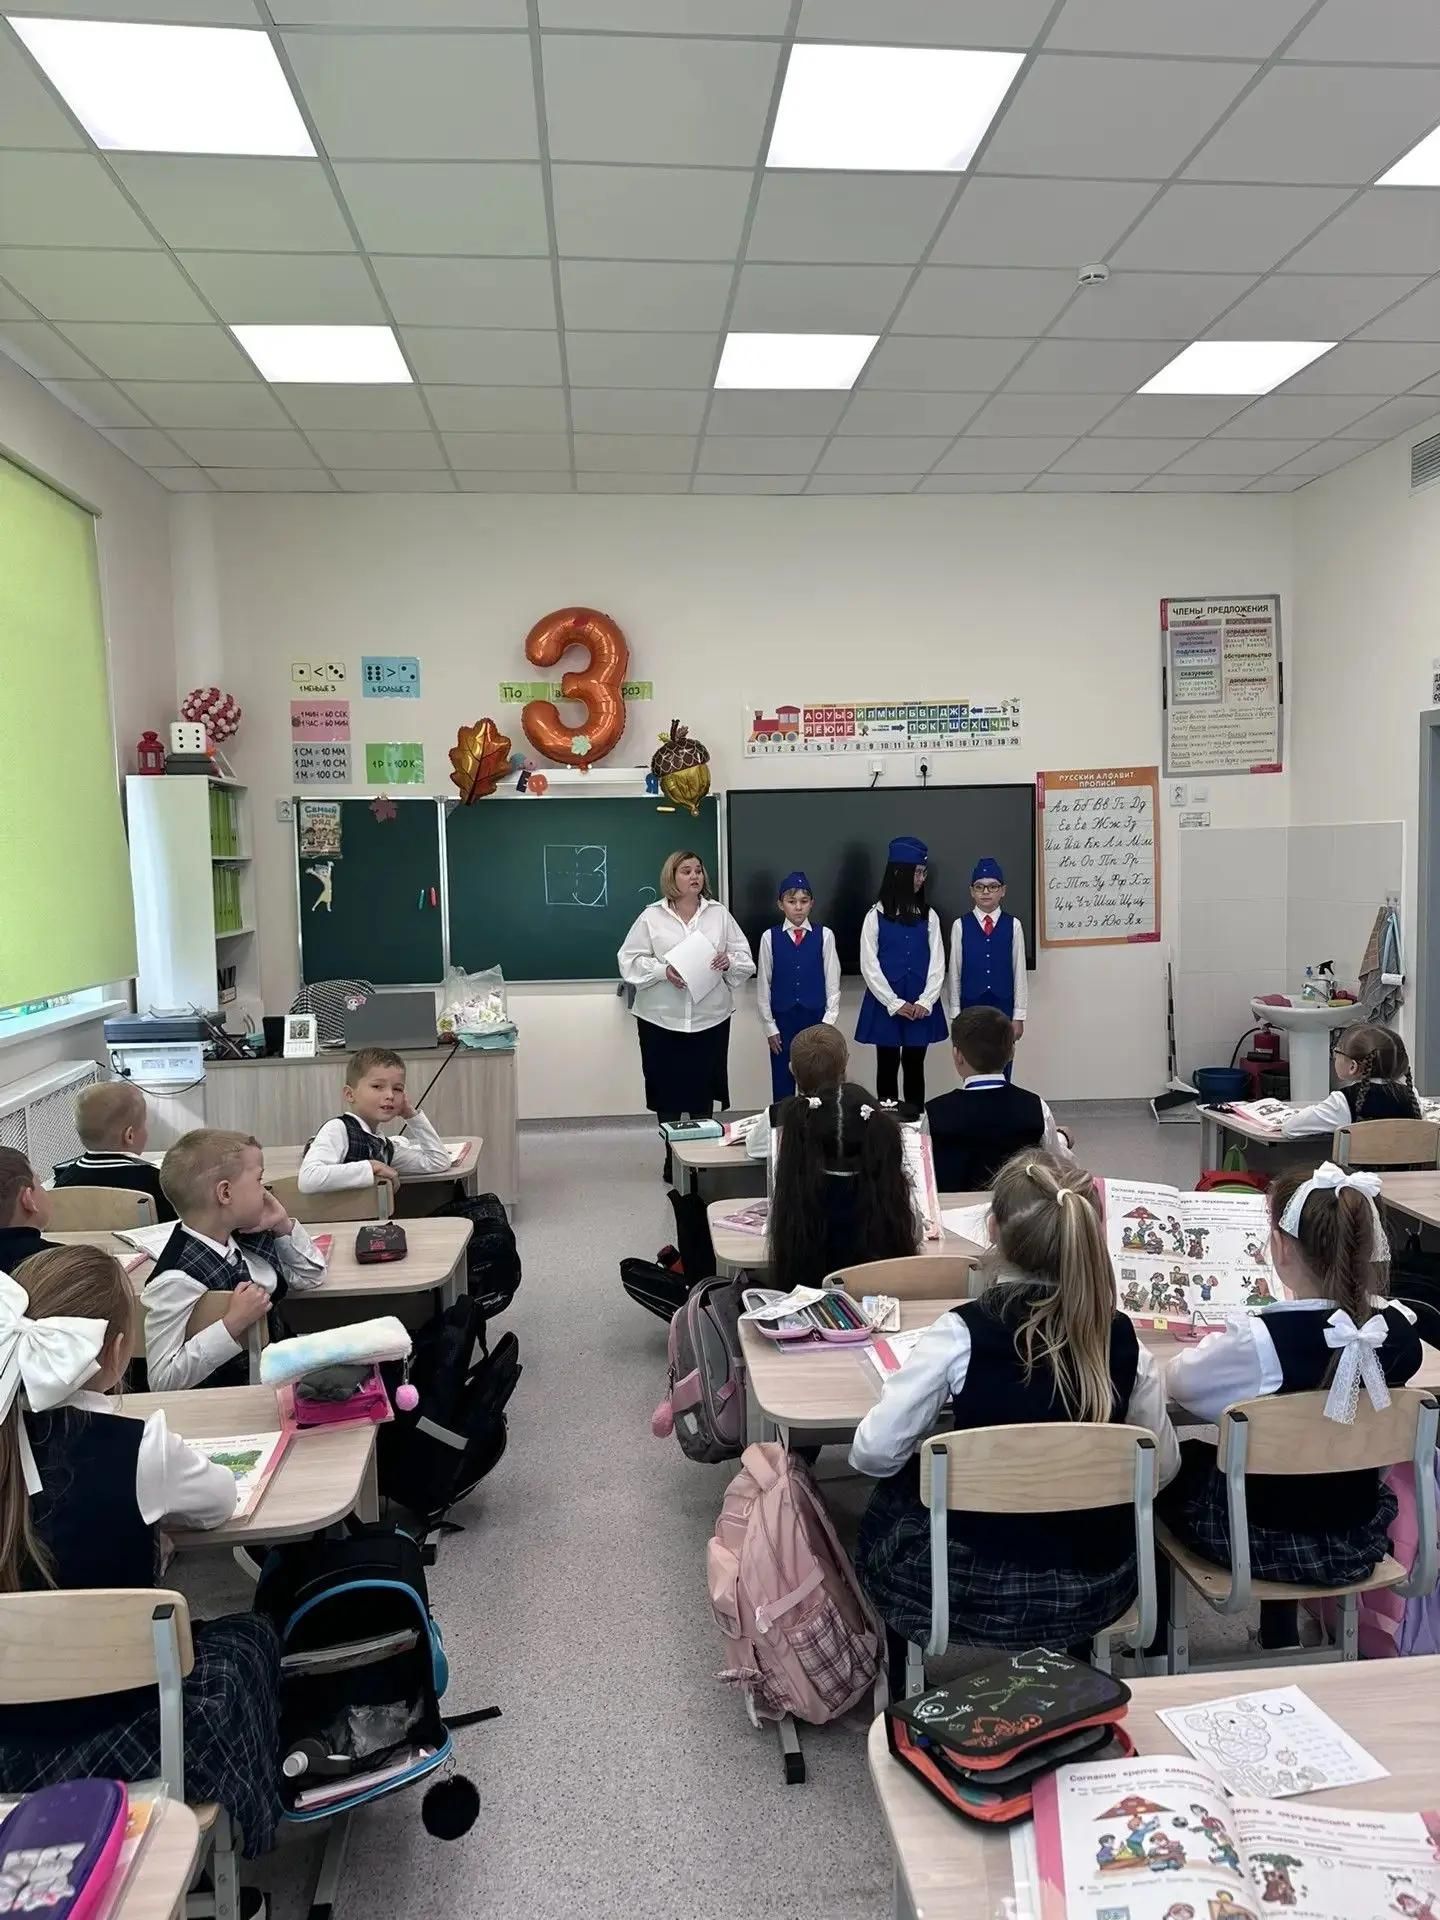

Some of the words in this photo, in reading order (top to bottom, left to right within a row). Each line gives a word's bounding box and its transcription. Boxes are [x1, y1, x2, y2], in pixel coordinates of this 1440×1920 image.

[1172, 608, 1204, 616] ЧЛЕНЫ
[1207, 604, 1269, 614] ПРЕДЛОЖЕНИЯ
[503, 687, 522, 698] По
[804, 712, 812, 720] А
[846, 711, 854, 719] Э
[857, 710, 863, 718] Й
[877, 710, 885, 718] М
[961, 707, 968, 715] З
[847, 725, 853, 733] Е
[941, 722, 946, 730] Т
[981, 721, 988, 730] Ц
[991, 720, 998, 728] Ч
[300, 747, 313, 756] СМ
[322, 748, 330, 756] 10
[300, 759, 314, 768] ДМ
[322, 759, 331, 767] 10
[333, 759, 346, 767] СМ
[377, 760, 384, 768] Р
[394, 760, 408, 768] 100
[409, 760, 415, 768] К
[301, 771, 308, 779] М
[1059, 773, 1094, 781] РУССКИЙ
[1096, 772, 1135, 780] АЛФАВИТ
[1050, 800, 1069, 812] Аа
[1073, 798, 1094, 811] Бб
[1093, 797, 1110, 810] Вв
[1112, 797, 1125, 809] Гг
[1130, 796, 1146, 813] Дд
[1092, 817, 1121, 829] Жж
[1124, 816, 1137, 832] Зз
[1044, 839, 1060, 851] Ии
[1064, 835, 1081, 850] Йй
[1084, 836, 1100, 848] Кк
[1103, 836, 1122, 847] Лл
[1126, 834, 1153, 847] Мм
[1059, 856, 1076, 867] Нн
[1081, 855, 1094, 866] Оо
[1098, 854, 1117, 866] Пп
[1123, 853, 1139, 868] Рр
[1049, 878, 1062, 889] Сс
[1064, 877, 1089, 888] Тт
[1093, 875, 1104, 891] Уу
[1109, 874, 1126, 890] Фф
[1129, 872, 1150, 885] Хх
[1055, 897, 1073, 911] Цц
[1075, 896, 1091, 907] Чч
[1094, 895, 1116, 907] Шш
[1120, 894, 1145, 908] Щщ
[1085, 915, 1098, 927] Ээ
[1101, 914, 1121, 926] Юю
[1124, 913, 1142, 925] Яя
